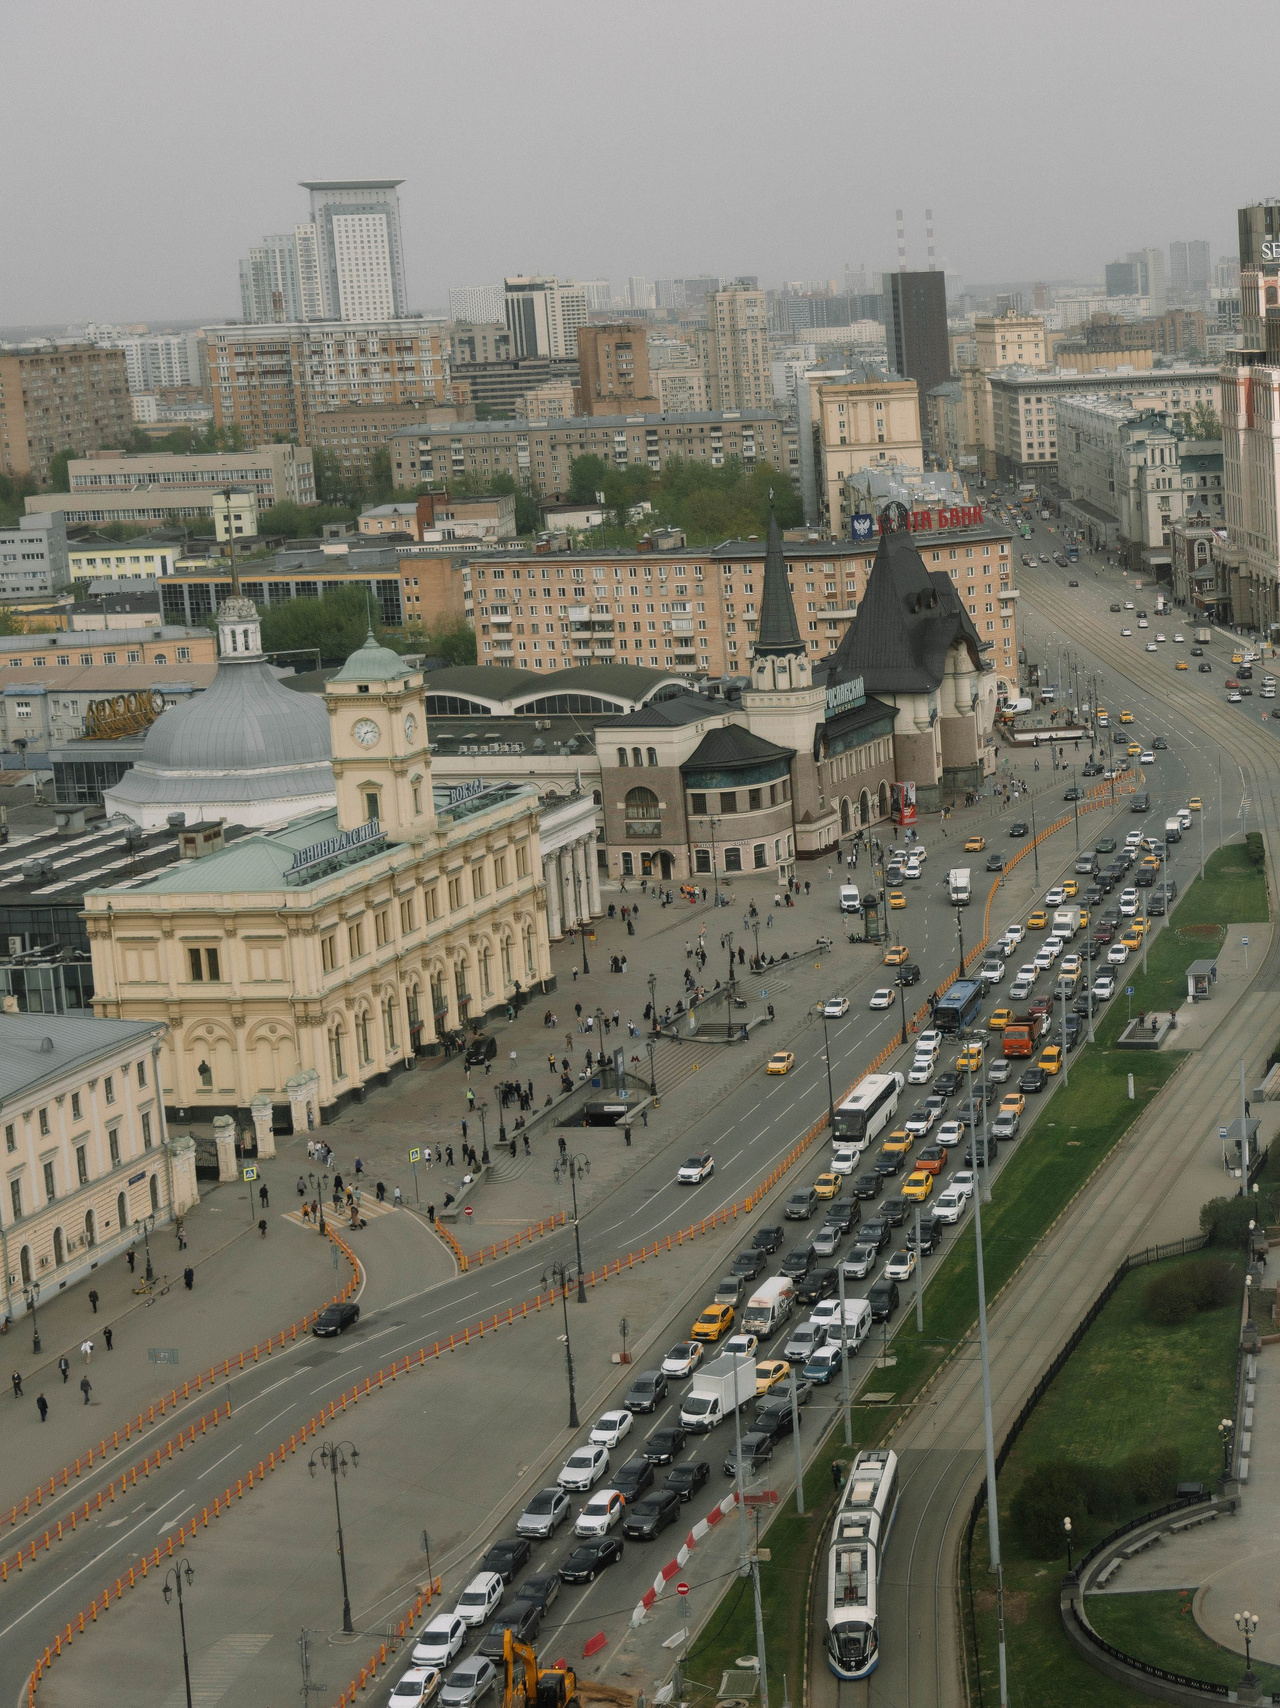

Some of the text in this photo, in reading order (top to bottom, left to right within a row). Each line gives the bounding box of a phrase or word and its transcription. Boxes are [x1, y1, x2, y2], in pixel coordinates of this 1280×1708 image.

[938, 505, 984, 529] БАНК
[825, 675, 865, 710] РОСЛАВСКИЙ
[293, 777, 484, 868] ЛЕНИНГРАДСКИЙ ВОКЗАЛ
